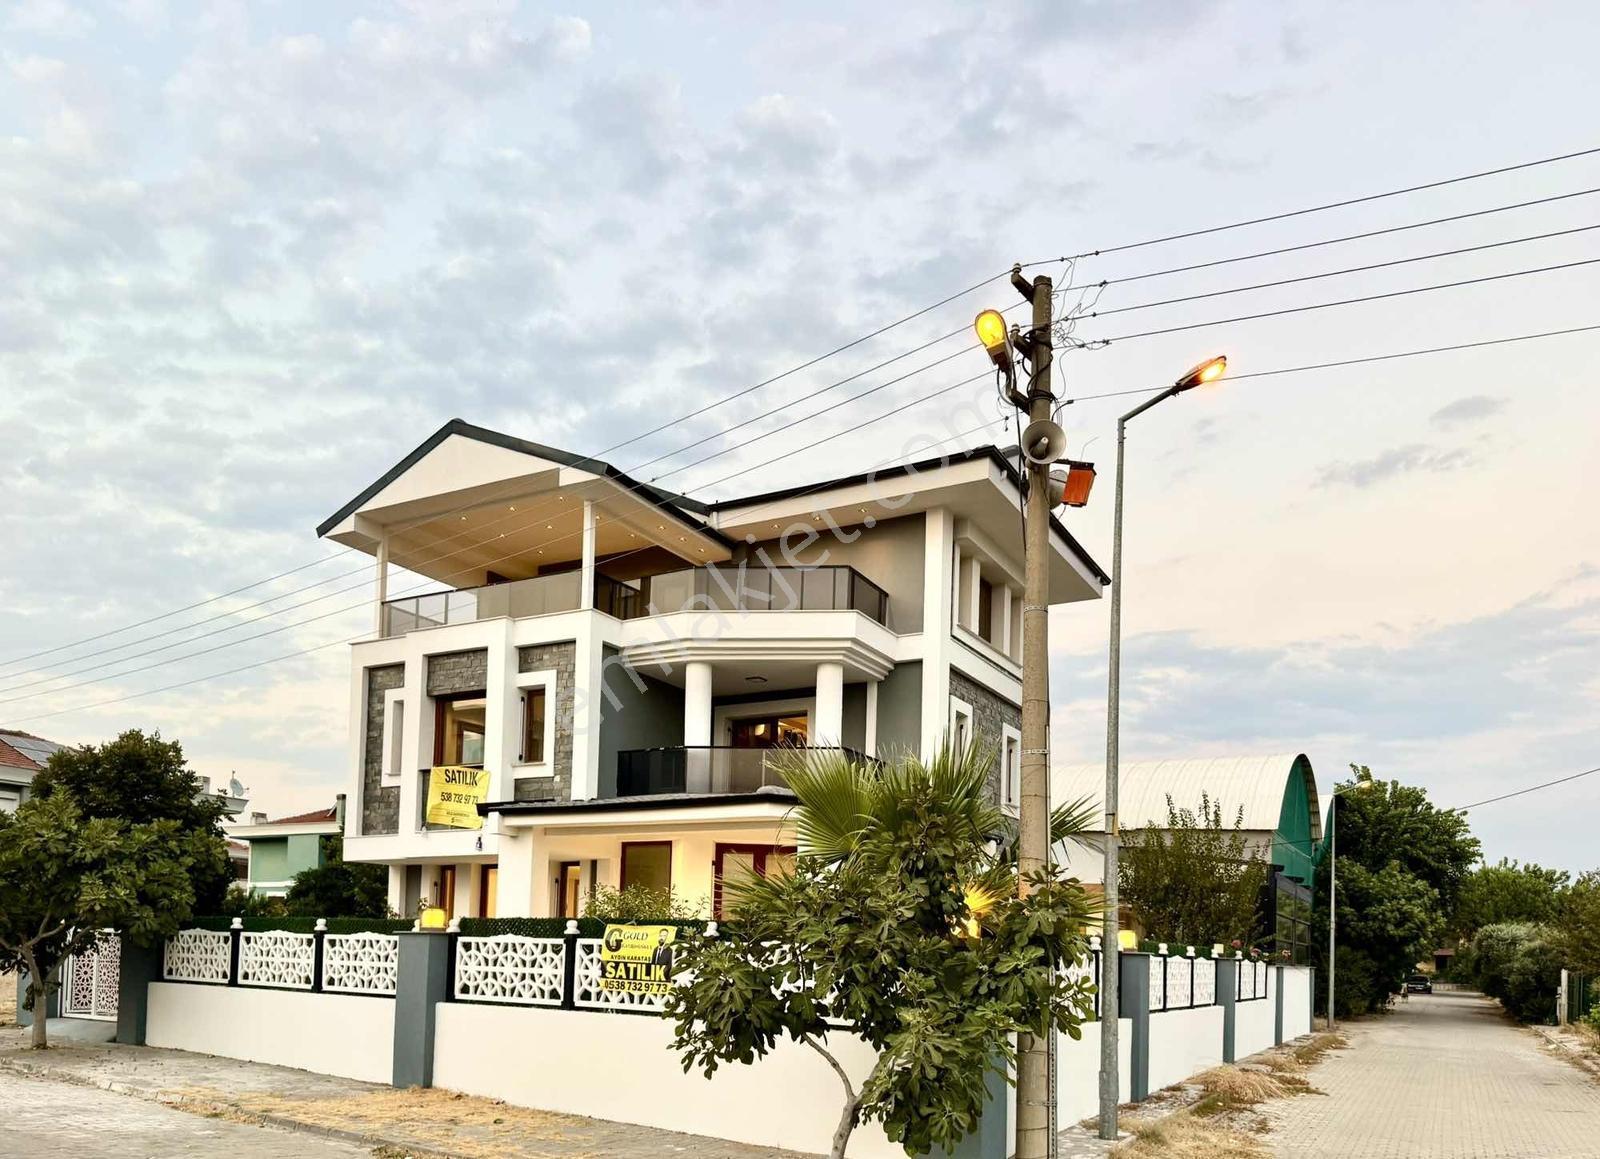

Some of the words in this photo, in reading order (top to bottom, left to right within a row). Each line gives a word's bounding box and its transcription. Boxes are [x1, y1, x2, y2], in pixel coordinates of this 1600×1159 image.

[445, 769, 478, 786] SATILIK
[441, 792, 452, 802] 538
[453, 793, 463, 803] 732
[605, 962, 667, 981] SATILIK
[604, 981, 626, 990] 0538
[627, 982, 643, 992] 732
[644, 983, 654, 993] 97
[656, 984, 668, 993] 73
